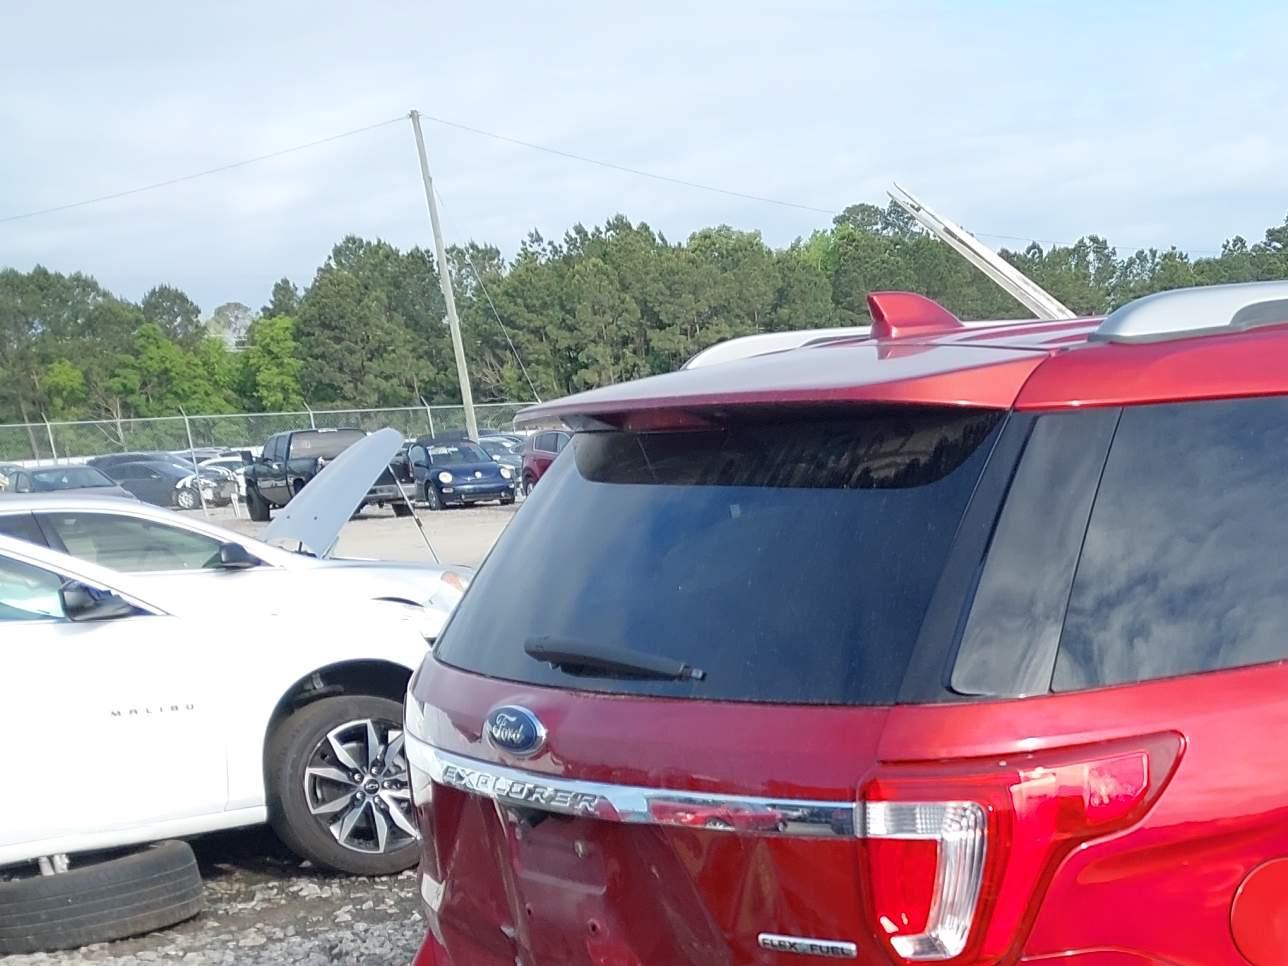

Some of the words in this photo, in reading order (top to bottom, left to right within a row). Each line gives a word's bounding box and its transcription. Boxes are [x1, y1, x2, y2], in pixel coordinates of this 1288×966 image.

[111, 704, 194, 717] MALIBU
[443, 766, 599, 812] EXPLORER
[761, 938, 798, 952] FLEX
[809, 943, 852, 956] FUEL
